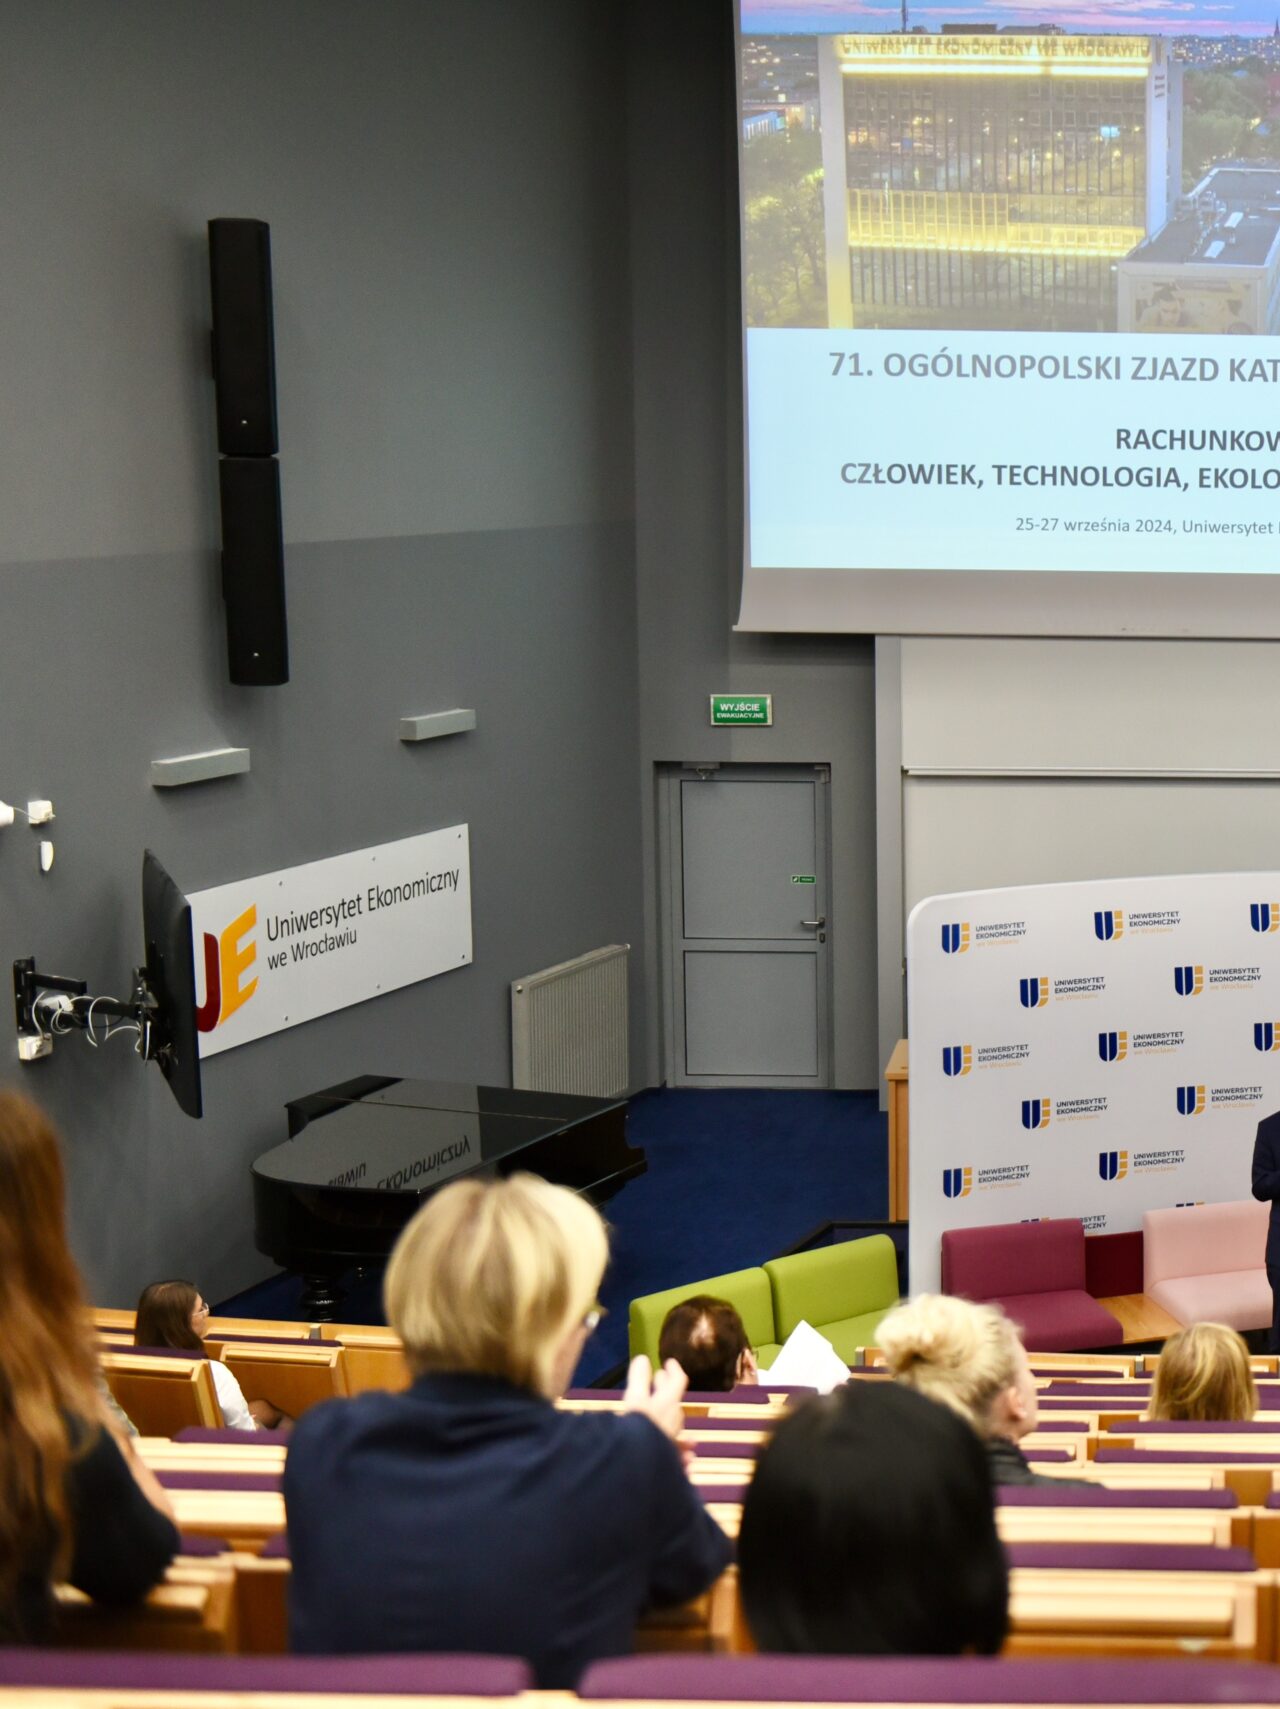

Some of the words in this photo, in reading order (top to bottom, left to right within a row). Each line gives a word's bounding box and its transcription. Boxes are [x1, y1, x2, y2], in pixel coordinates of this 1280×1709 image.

[830, 353, 873, 376] 71.
[883, 347, 1121, 380] OGÓLNOPOLSKI
[1130, 356, 1219, 381] ZJAZD
[840, 463, 984, 489] CZŁOWIEK,
[992, 465, 1189, 492] TECHNOLOGIA,
[1015, 517, 1059, 531] 25-27
[1064, 517, 1130, 532] września
[1135, 519, 1177, 534] 2024,
[1182, 519, 1274, 536] Uniwersytet
[720, 701, 760, 711] WYJŚCIE
[267, 894, 363, 942] Uniwersytet
[368, 867, 460, 912] Ekonomiczny
[1129, 910, 1179, 920] UNIWERSYTET
[976, 922, 1025, 933] UNIWERSYTET
[1129, 918, 1181, 928] EKONOMICZNY
[976, 929, 1027, 940] EKONOMICZNY
[268, 950, 288, 970] we
[292, 929, 358, 962] Wrocławiu
[1209, 968, 1260, 976] UNIWERSYTET
[1054, 977, 1105, 987] UNIWERSYTET
[1210, 975, 1262, 983] EKONOMICZNY
[1055, 984, 1106, 994] EKONOMICZNY
[1133, 1031, 1184, 1041] UNIWERSYTET
[1133, 1038, 1185, 1048] EKONOMICZNY
[978, 1044, 1029, 1055] UNIWERSYTET
[978, 1051, 1030, 1063] EKONOMICZNY
[1211, 1086, 1263, 1095] UNIWERSYTET
[1056, 1097, 1107, 1108] UNIWERSYTET
[1212, 1093, 1264, 1102] EKONOMICZNY
[1057, 1104, 1108, 1116] EKONOMICZNY
[1134, 1149, 1185, 1160] UNIWERSYTET
[1134, 1156, 1186, 1167] EKONOMICZNY
[978, 1165, 1029, 1177] UNIWERSYTET
[978, 1171, 1031, 1184] EKONOMICZNY
